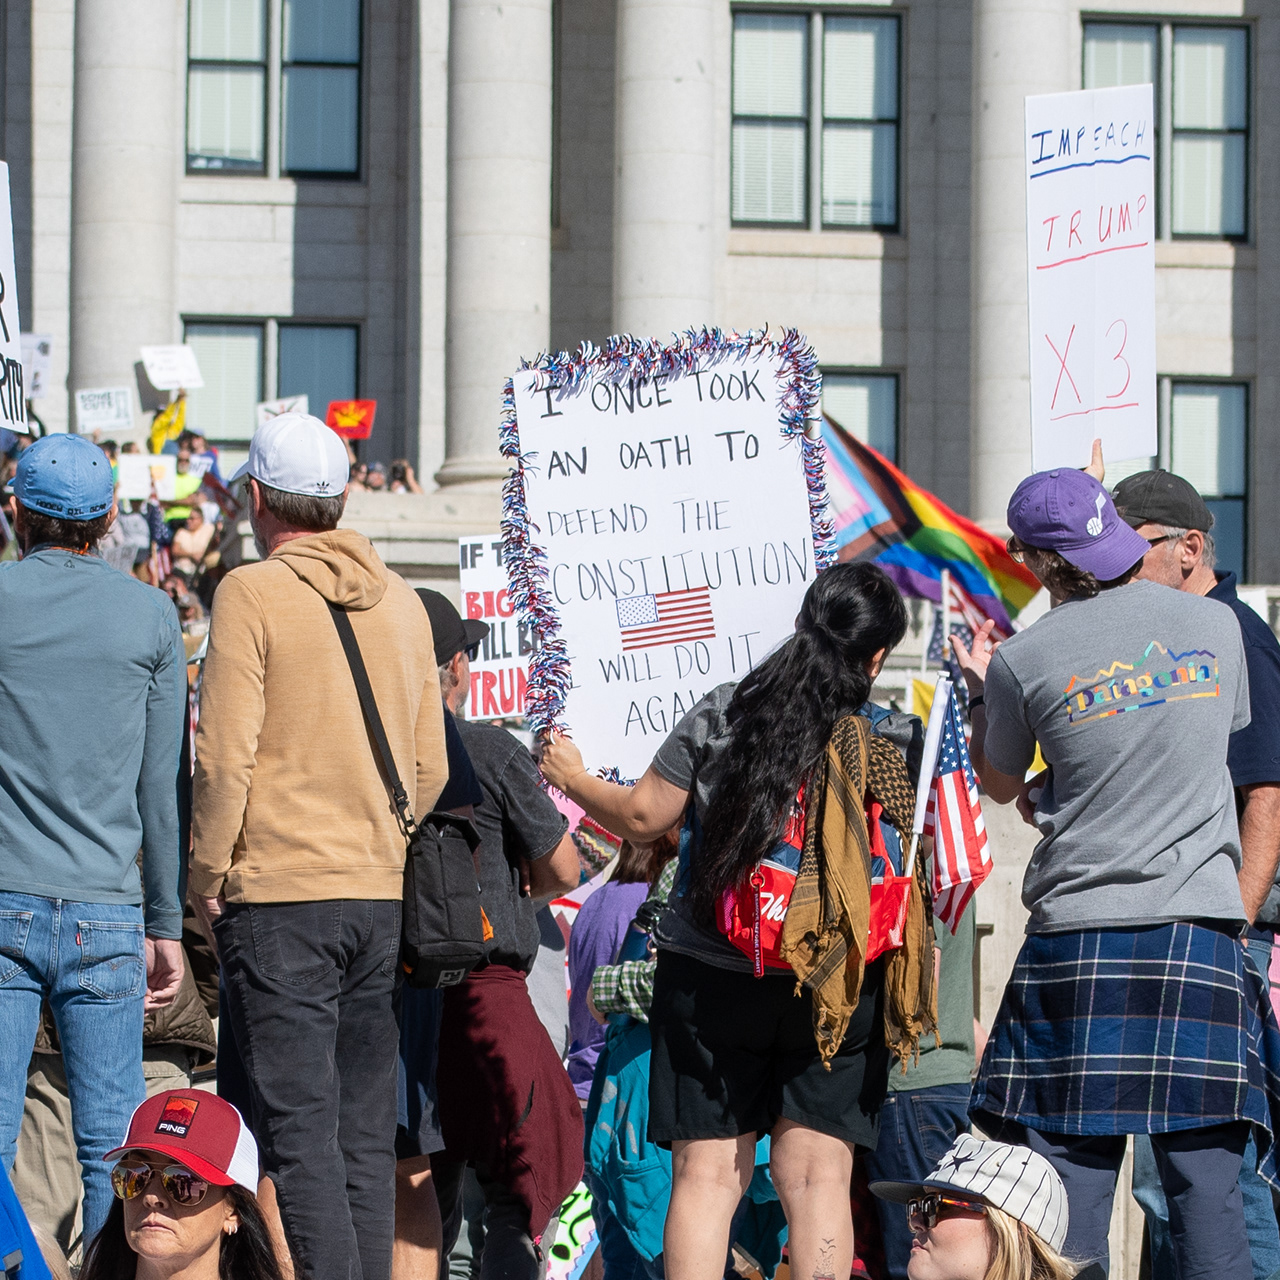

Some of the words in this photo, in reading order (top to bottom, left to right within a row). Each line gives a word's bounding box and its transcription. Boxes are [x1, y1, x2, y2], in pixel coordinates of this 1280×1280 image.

[1031, 120, 1146, 164] IMPEACH
[1042, 195, 1147, 253] TRUMP
[1045, 324, 1081, 409] X
[1104, 319, 1130, 399] 3
[591, 375, 673, 416] ONCE
[693, 368, 767, 403] TOOK
[548, 446, 587, 480] AN
[620, 434, 692, 471] OATH
[715, 430, 759, 462] TO
[548, 504, 648, 538] DEFEND
[673, 497, 731, 534] THE
[460, 543, 484, 570] IF
[599, 650, 661, 683] WILL
[675, 640, 712, 680] DO
[725, 630, 761, 671] IT
[1076, 662, 1212, 713] patagonia
[158, 1122, 187, 1134] PING
